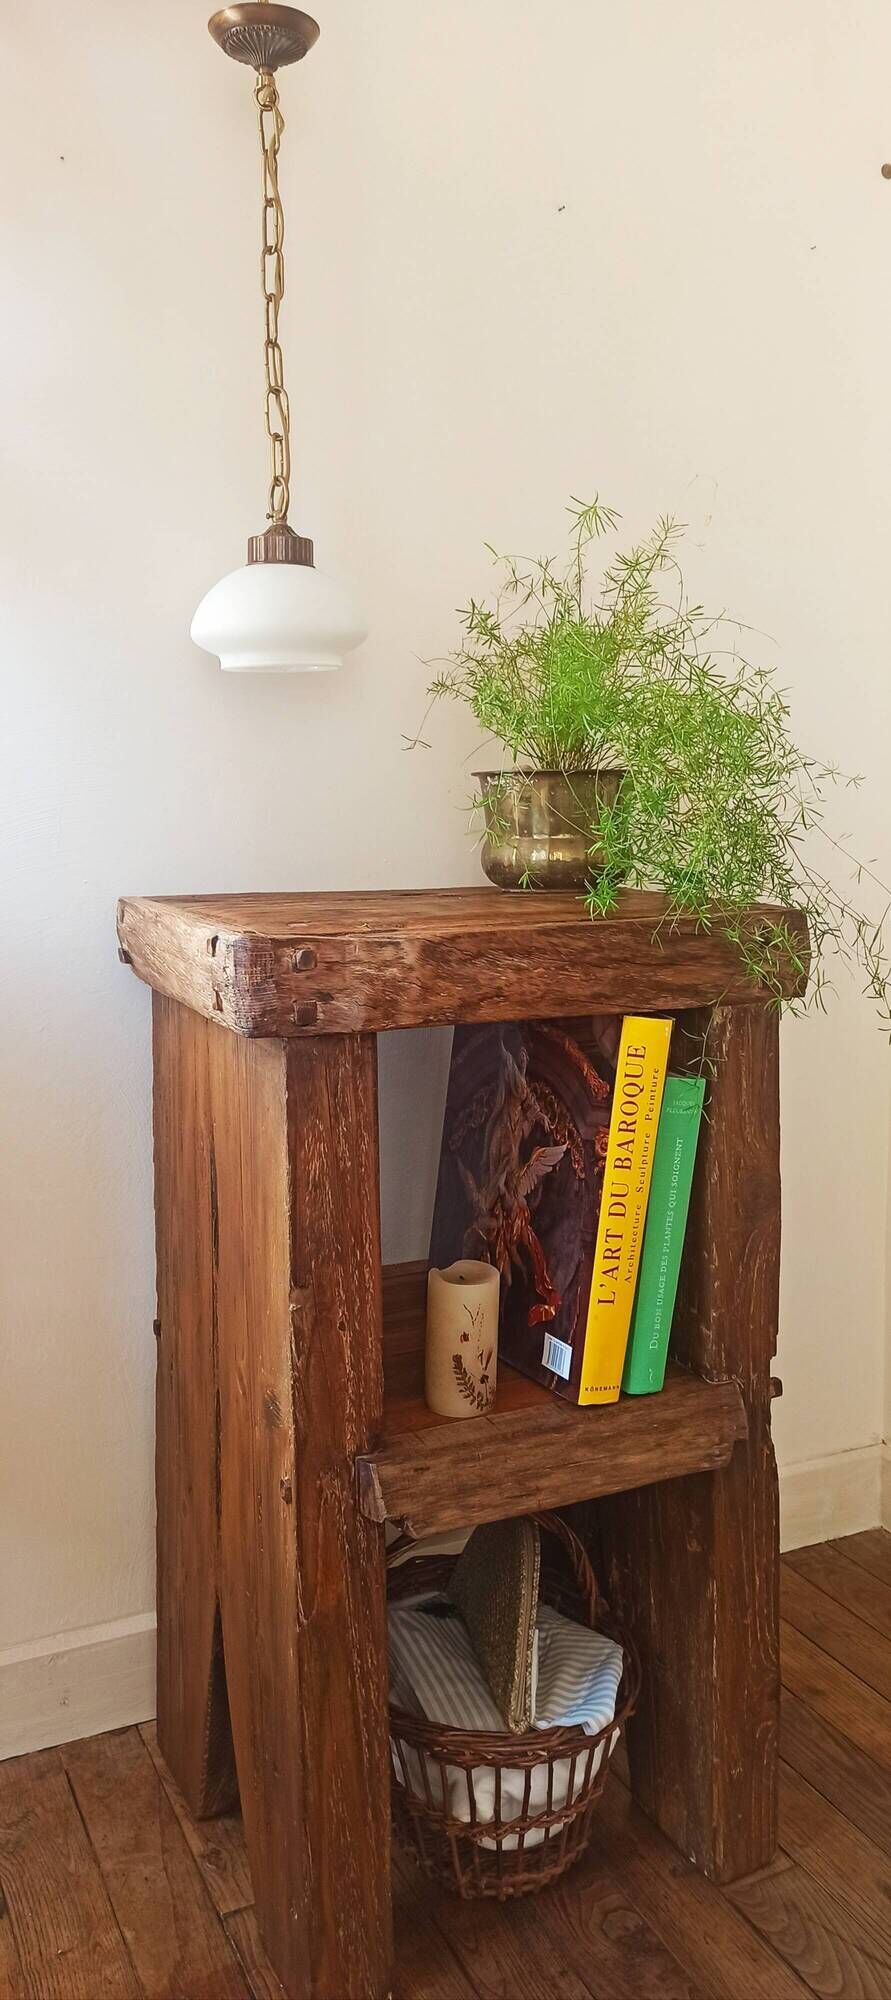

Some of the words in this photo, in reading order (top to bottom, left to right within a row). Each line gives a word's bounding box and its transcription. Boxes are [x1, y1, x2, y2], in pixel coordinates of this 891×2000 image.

[613, 1045, 647, 1171] BAROQUE
[624, 1204, 642, 1284] Architecture
[636, 1132, 651, 1193] Sculpture
[644, 1067, 660, 1121] Peinture
[670, 1137, 684, 1187] SOIGNENT
[608, 1181, 629, 1219] DU
[668, 1189, 677, 1208] QUI
[662, 1210, 674, 1253] PLANTES
[597, 1228, 624, 1305] L'ART
[660, 1255, 668, 1273] DES
[656, 1274, 668, 1305] USAGE
[654, 1310, 662, 1330] BON
